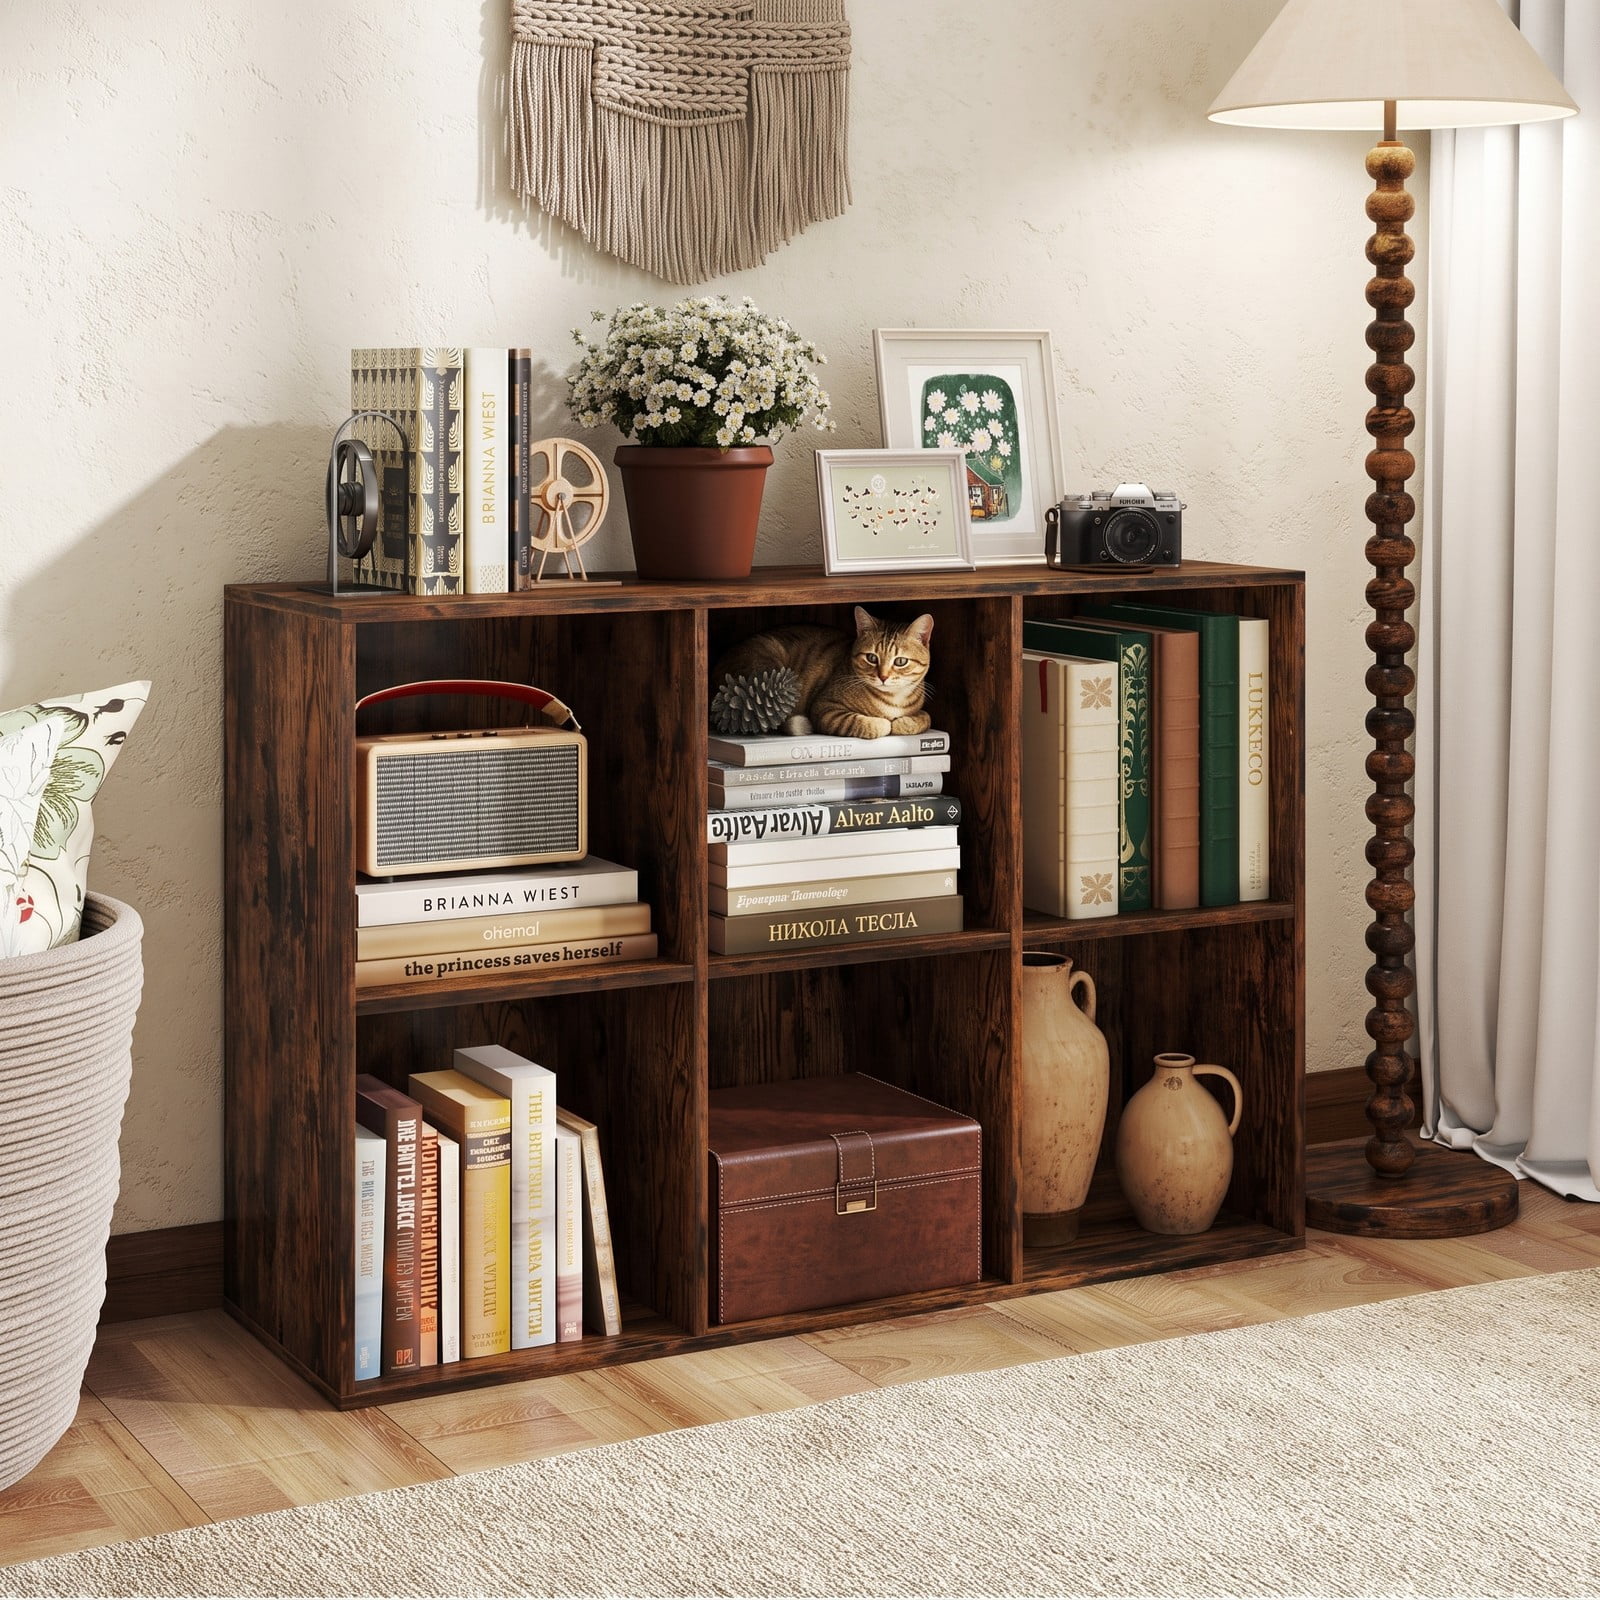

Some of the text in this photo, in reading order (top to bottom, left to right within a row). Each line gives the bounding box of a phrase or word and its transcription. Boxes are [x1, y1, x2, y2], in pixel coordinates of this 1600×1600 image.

[482, 391, 496, 525] BRIANNA WIEST
[1248, 672, 1264, 787] LUKKECO
[819, 743, 853, 758] FIRE
[834, 805, 935, 828] Alvar Aalto
[423, 885, 580, 912] BRIANNA WIEST
[768, 911, 919, 942] НИКОЛА ТЕСЛА
[404, 942, 623, 977] the princess saves herself
[528, 1090, 543, 1126] THE
